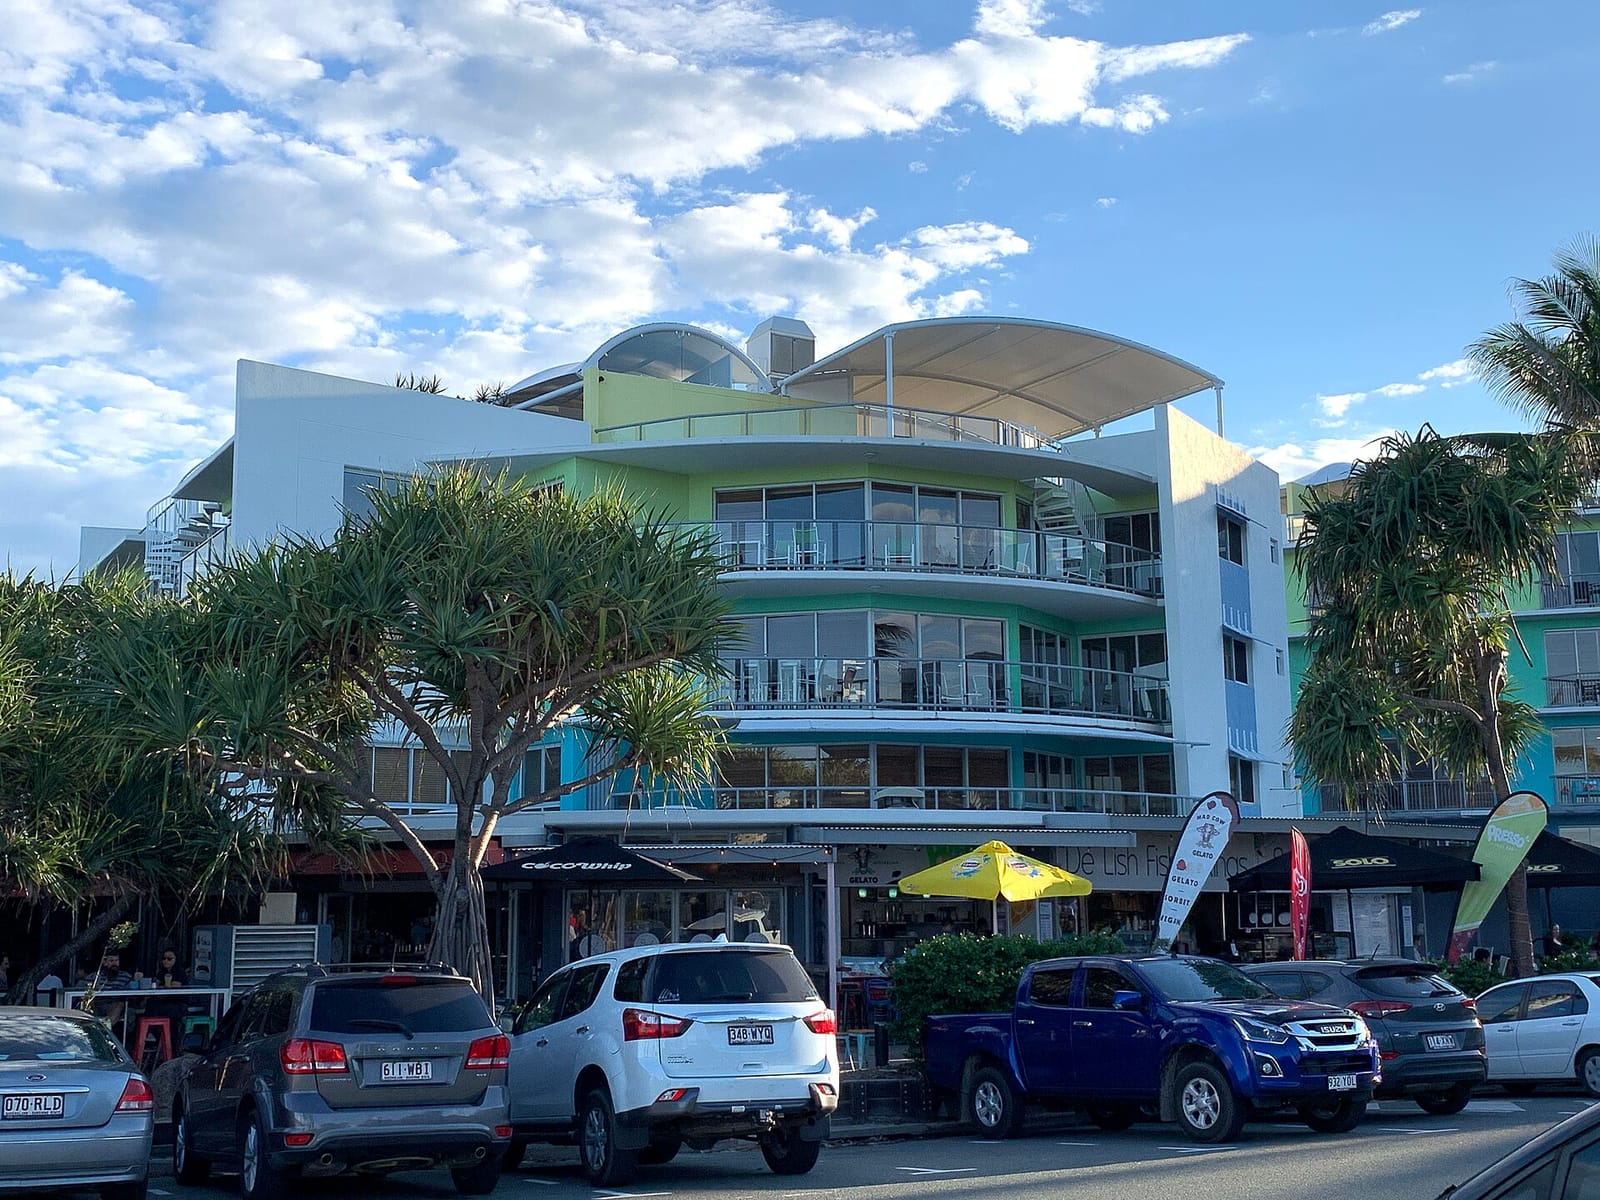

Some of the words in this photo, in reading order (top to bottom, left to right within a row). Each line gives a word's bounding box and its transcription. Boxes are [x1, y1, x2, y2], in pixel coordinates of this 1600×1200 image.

[1212, 815, 1226, 825] COW
[1192, 849, 1213, 859] GELATO
[1104, 846, 1139, 876] Lish
[1332, 857, 1390, 867] SOLO
[849, 876, 879, 884] GELATO
[1171, 875, 1199, 887] GELATO
[1320, 1024, 1347, 1033] ISUZU
